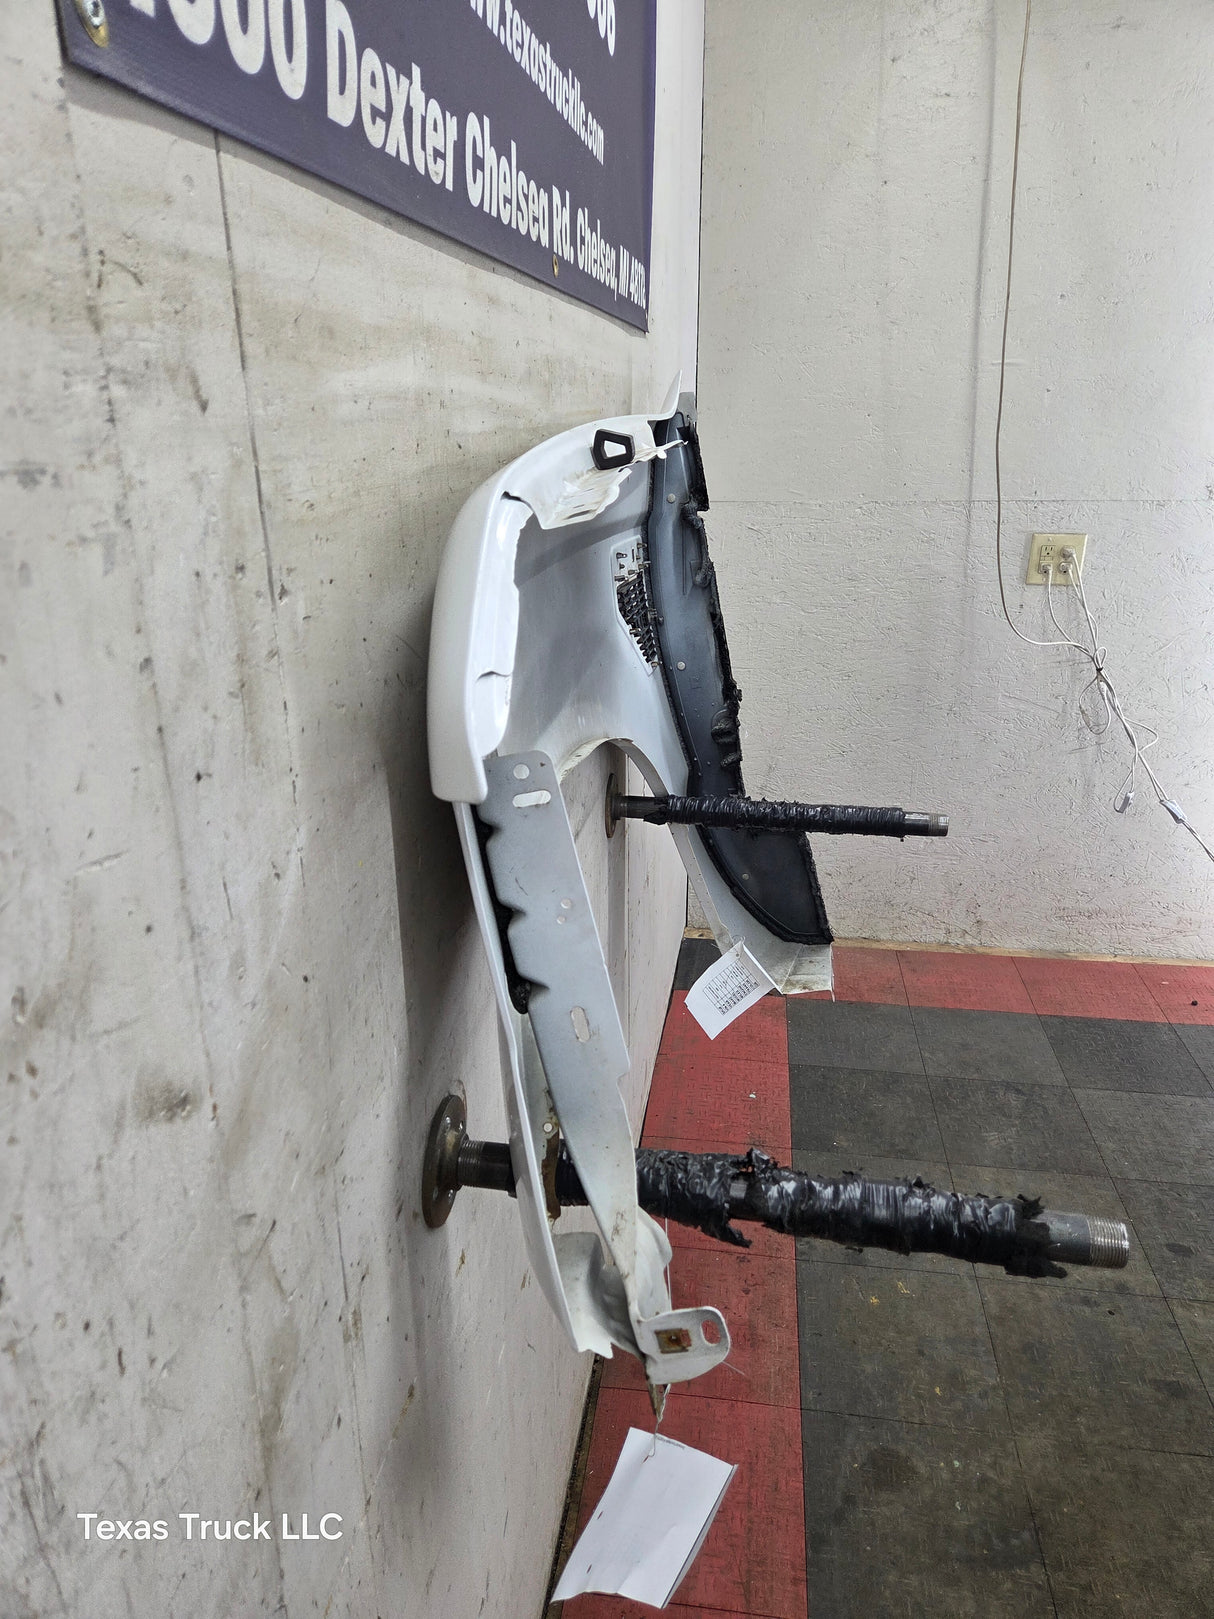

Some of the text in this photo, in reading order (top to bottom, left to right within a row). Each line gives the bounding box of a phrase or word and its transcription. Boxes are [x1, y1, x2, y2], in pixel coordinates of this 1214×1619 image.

[325, 0, 458, 192] Dexter
[465, 112, 549, 248] Chelsea
[552, 185, 575, 265] Rd.
[576, 207, 618, 302] Chelsea,
[618, 244, 630, 299] MI
